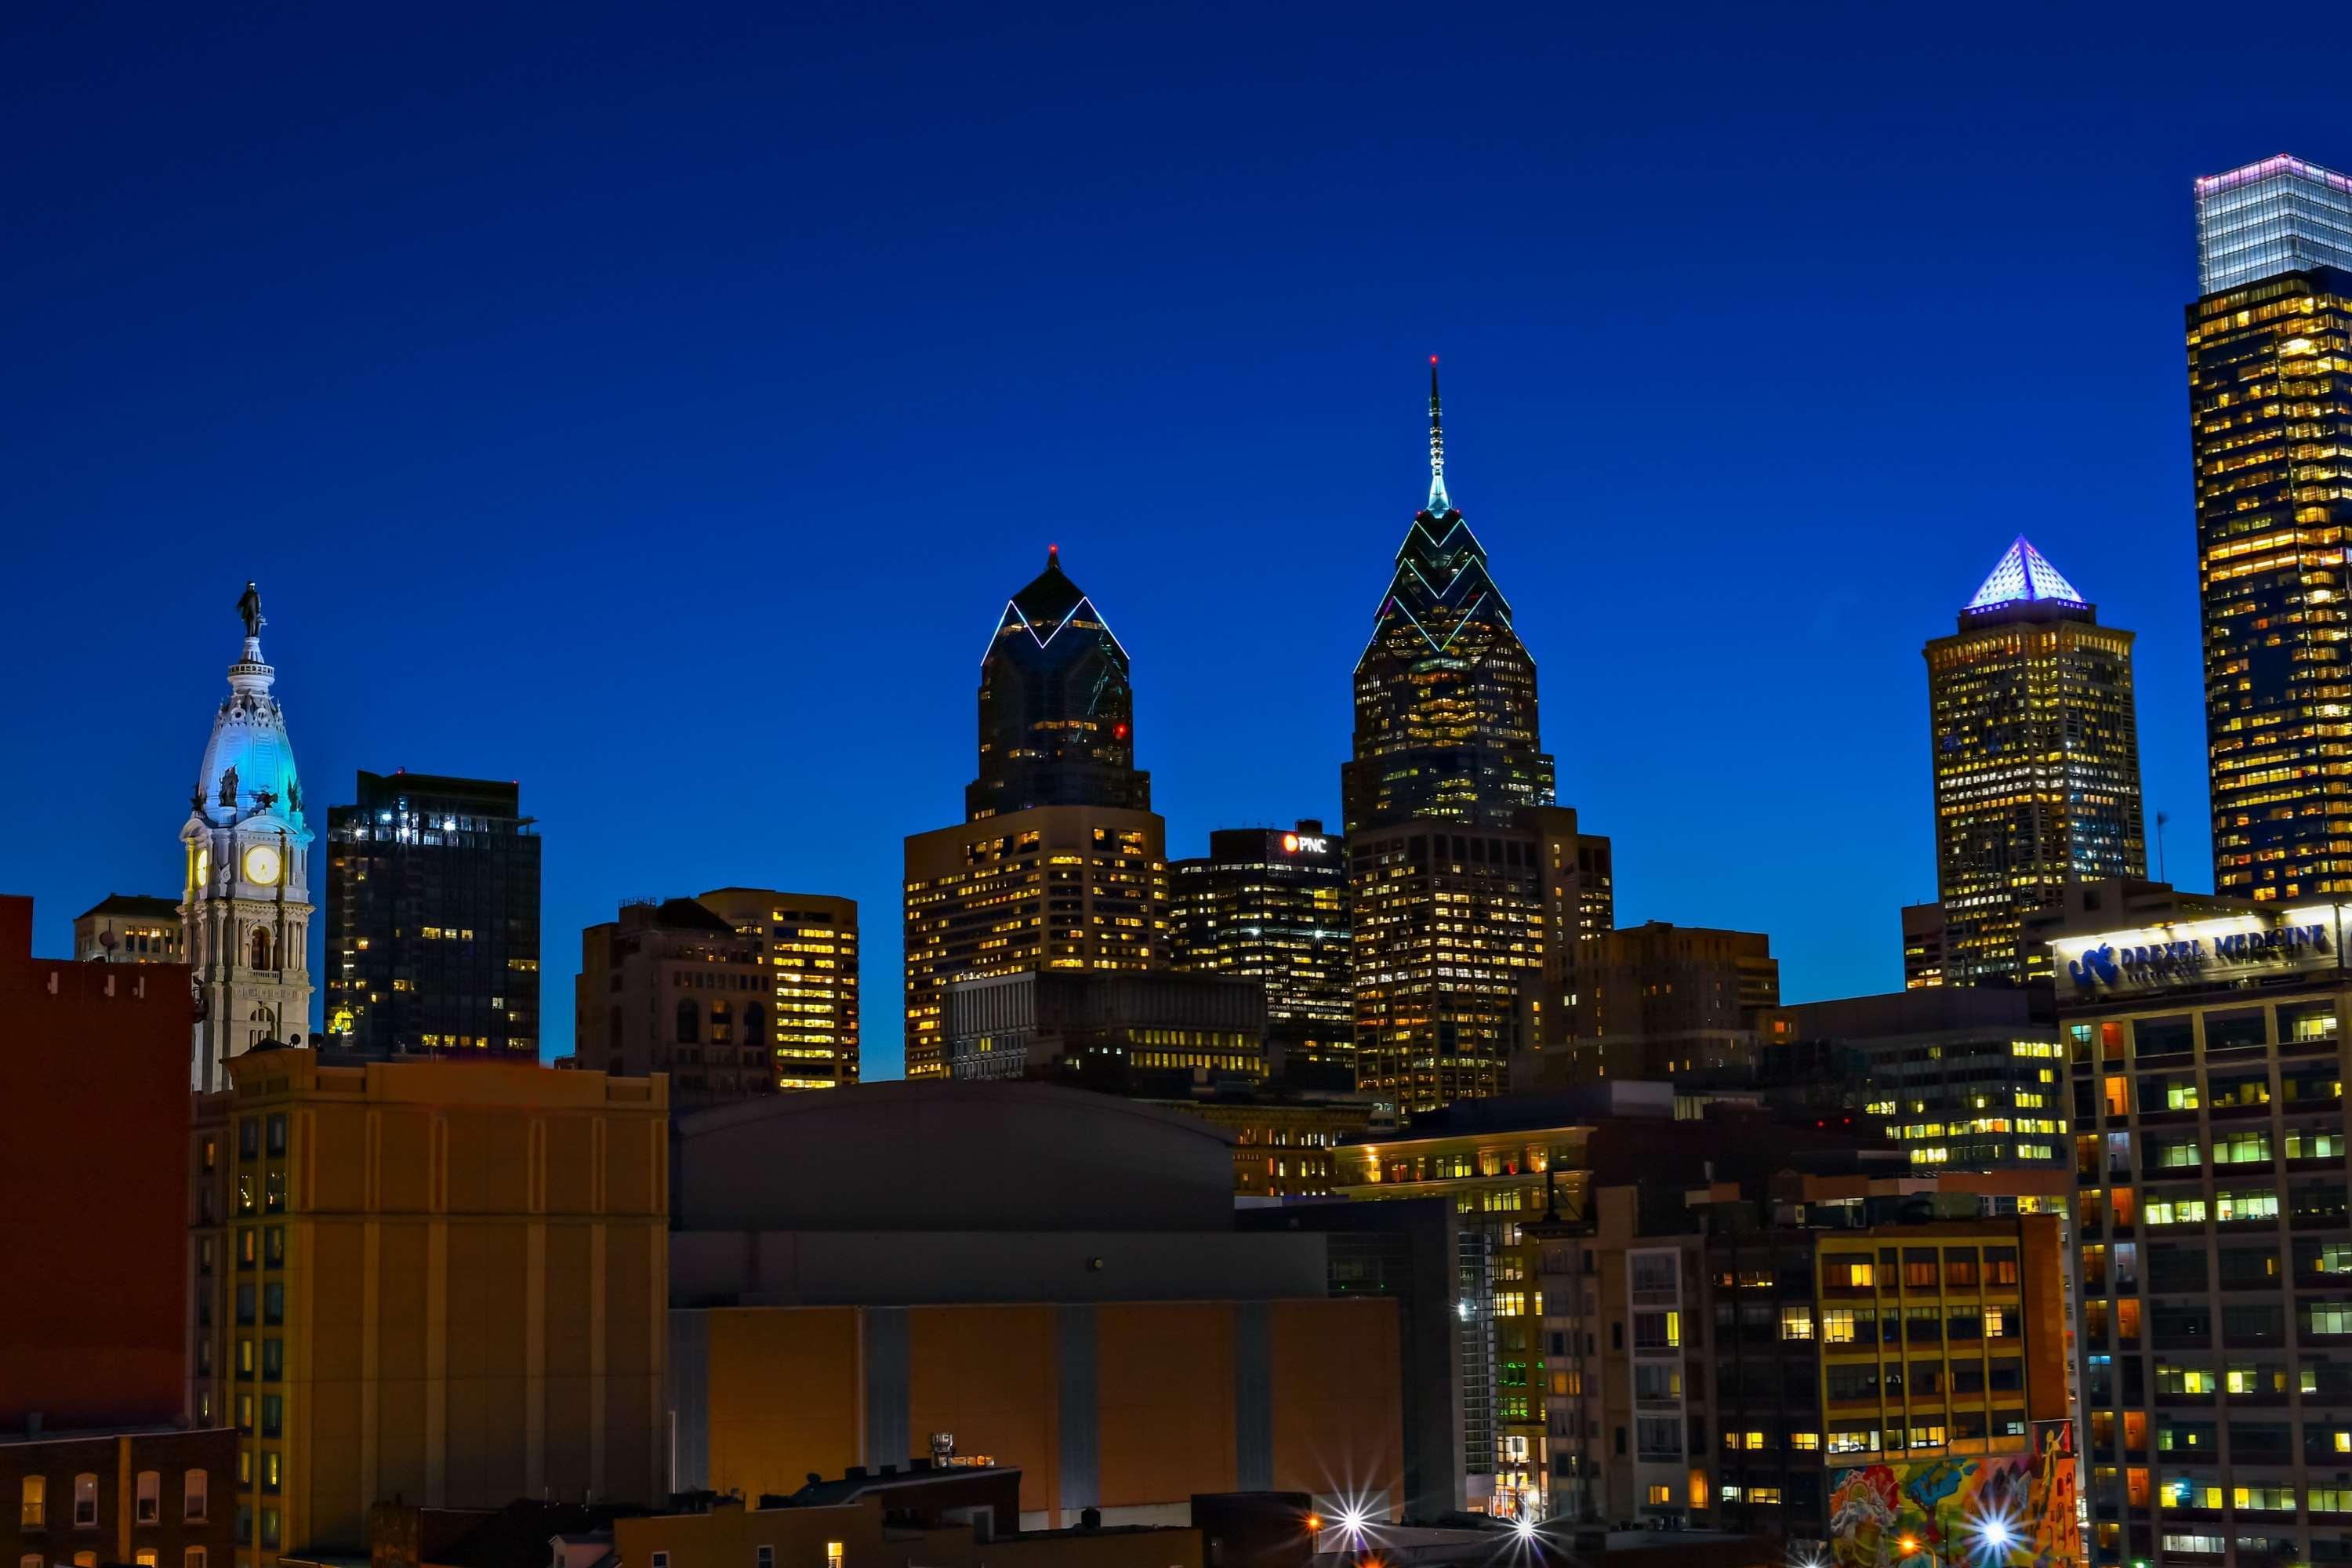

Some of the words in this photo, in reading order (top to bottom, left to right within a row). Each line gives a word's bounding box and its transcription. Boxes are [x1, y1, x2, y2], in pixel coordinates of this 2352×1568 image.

[1298, 837, 1327, 854] PNC
[2120, 939, 2206, 967] DREXEL
[2214, 924, 2325, 957] MEDICINE
